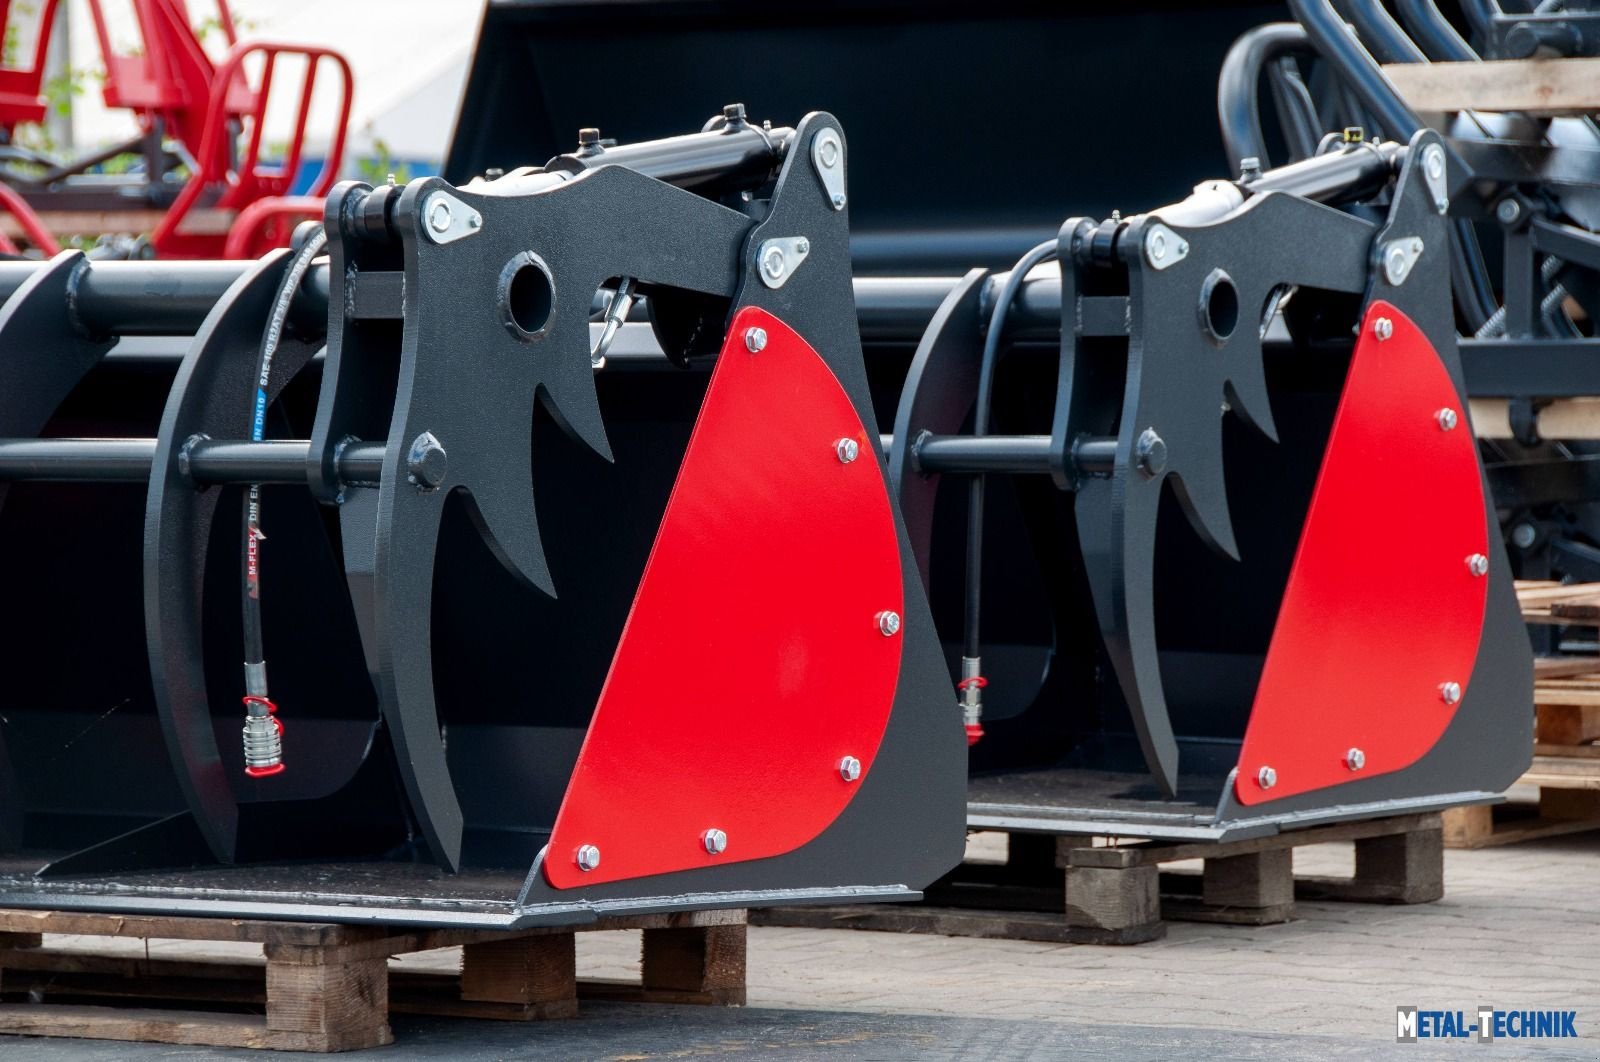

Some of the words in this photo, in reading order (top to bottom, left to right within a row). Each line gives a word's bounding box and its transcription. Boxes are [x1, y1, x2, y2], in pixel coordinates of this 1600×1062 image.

[264, 343, 274, 361] 100
[260, 364, 270, 386] SAE
[255, 398, 265, 425] DN10
[250, 484, 259, 499] EN
[249, 502, 257, 521] DIN
[249, 533, 257, 575] M-FLEX
